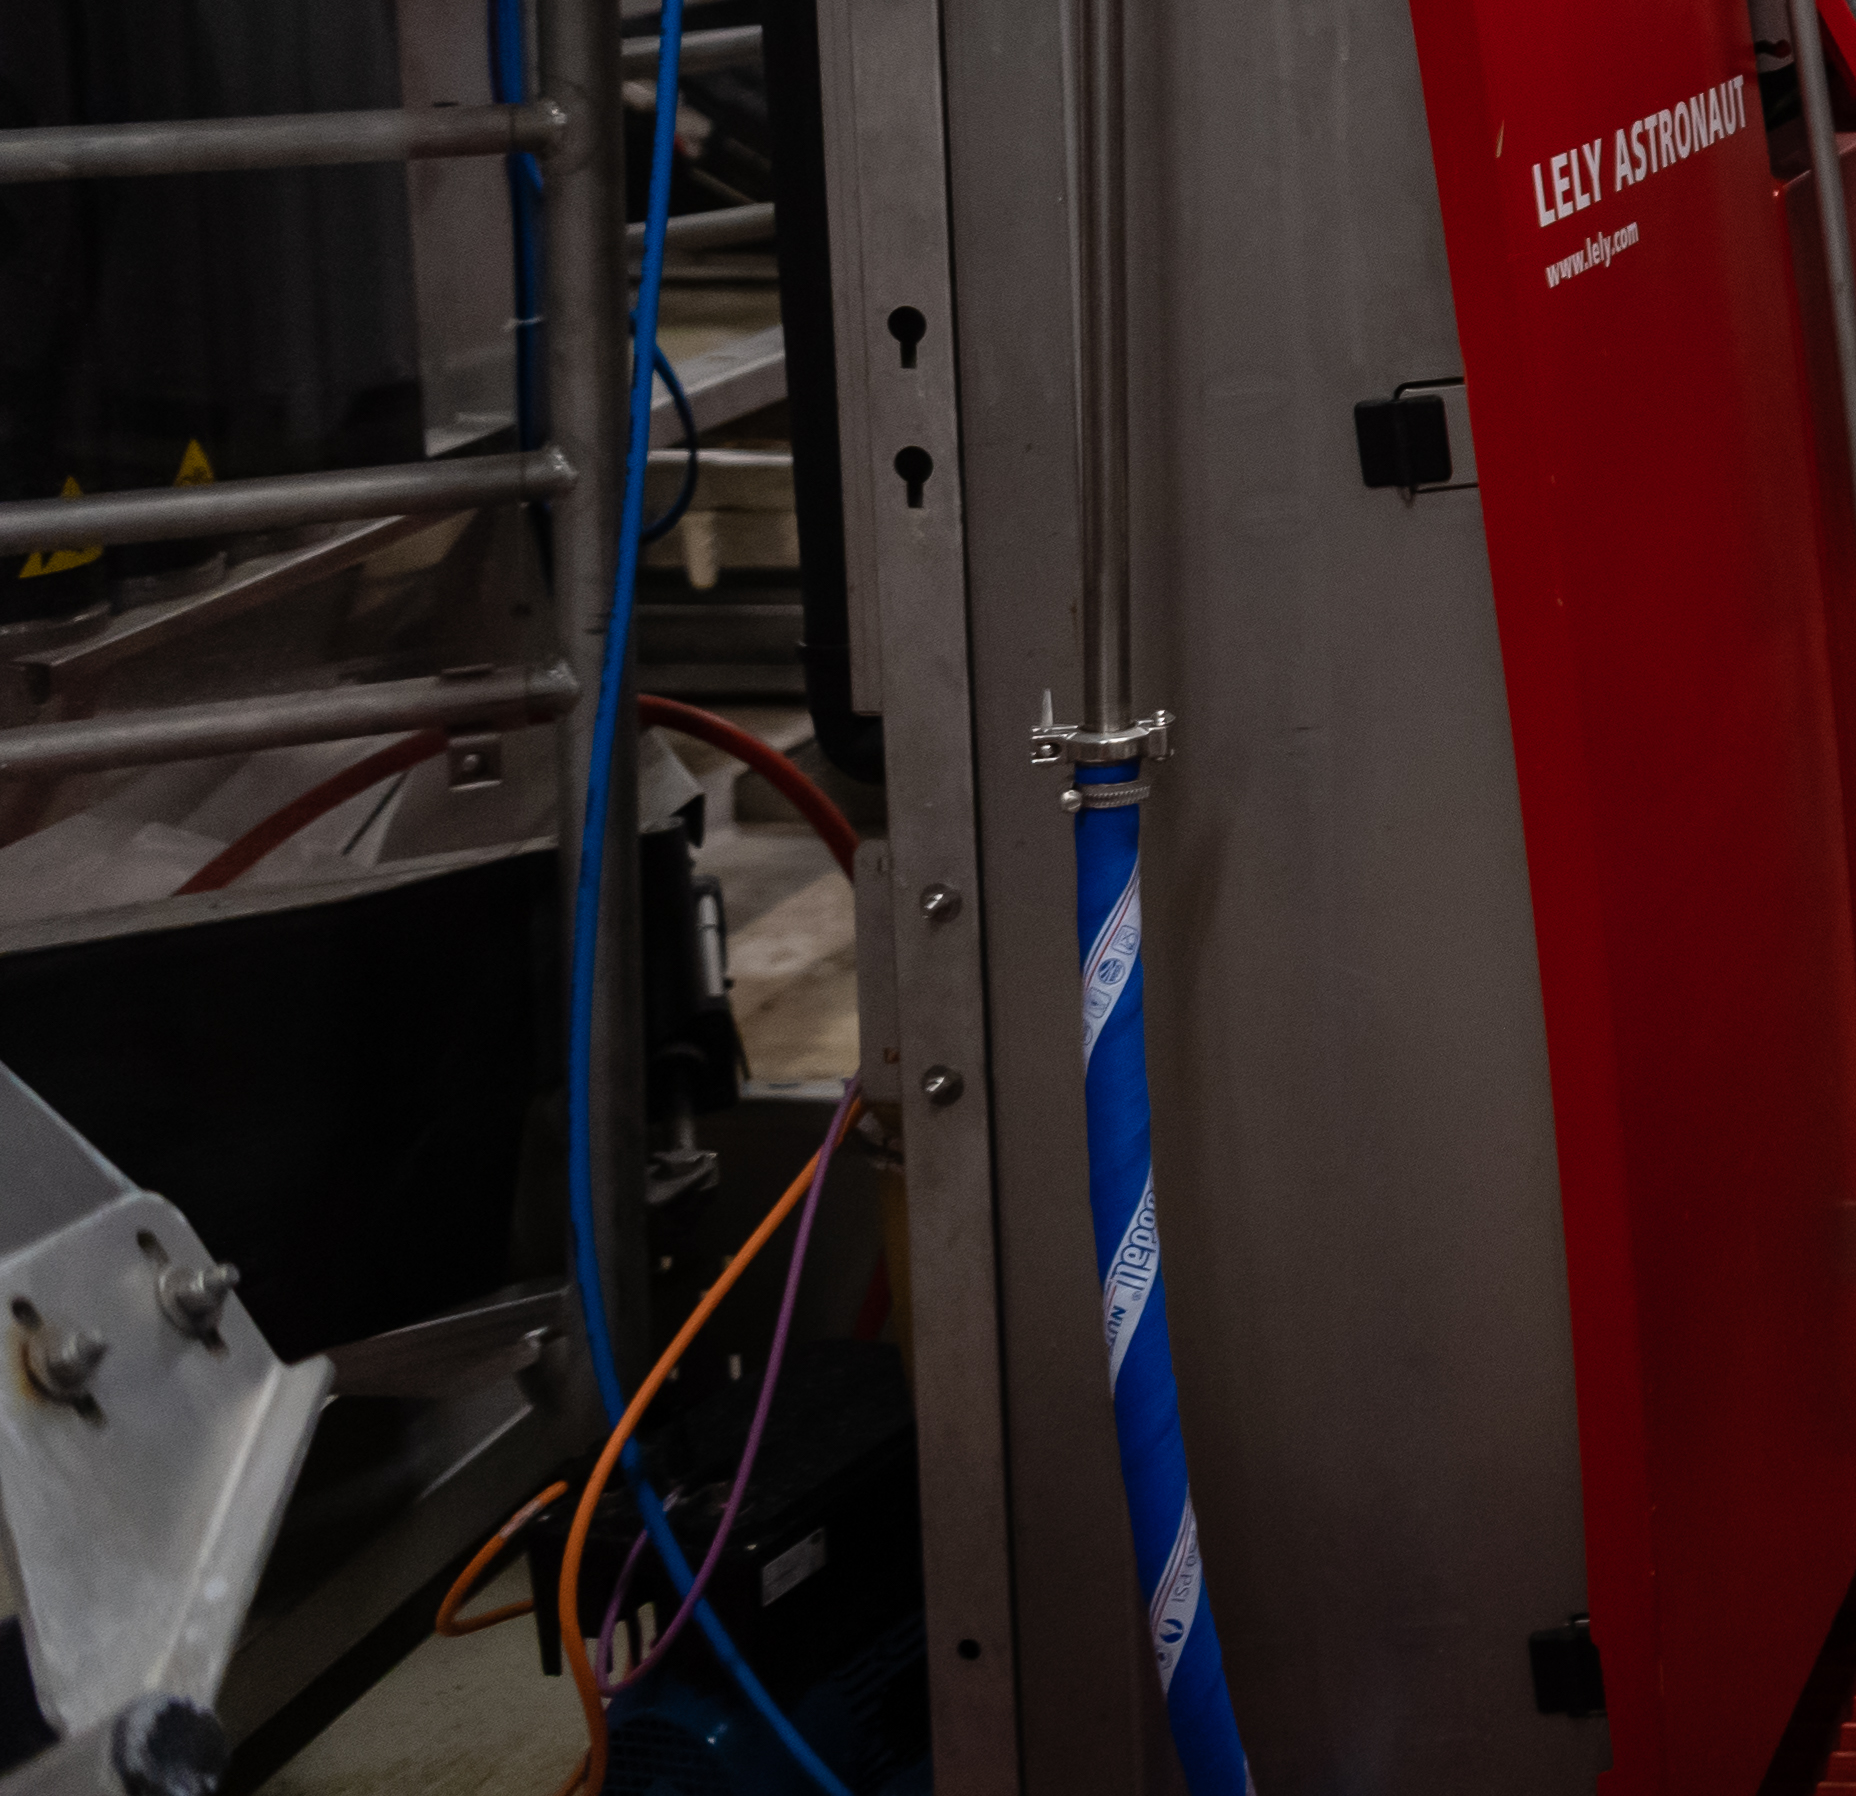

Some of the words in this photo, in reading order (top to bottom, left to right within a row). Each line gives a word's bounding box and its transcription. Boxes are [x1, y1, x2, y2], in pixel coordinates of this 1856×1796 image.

[1532, 137, 1602, 228] LELY
[1614, 75, 1746, 193] ASTRONAUT
[1545, 220, 1639, 288] www.lely.com
[1171, 1573, 1193, 1603] PSI
